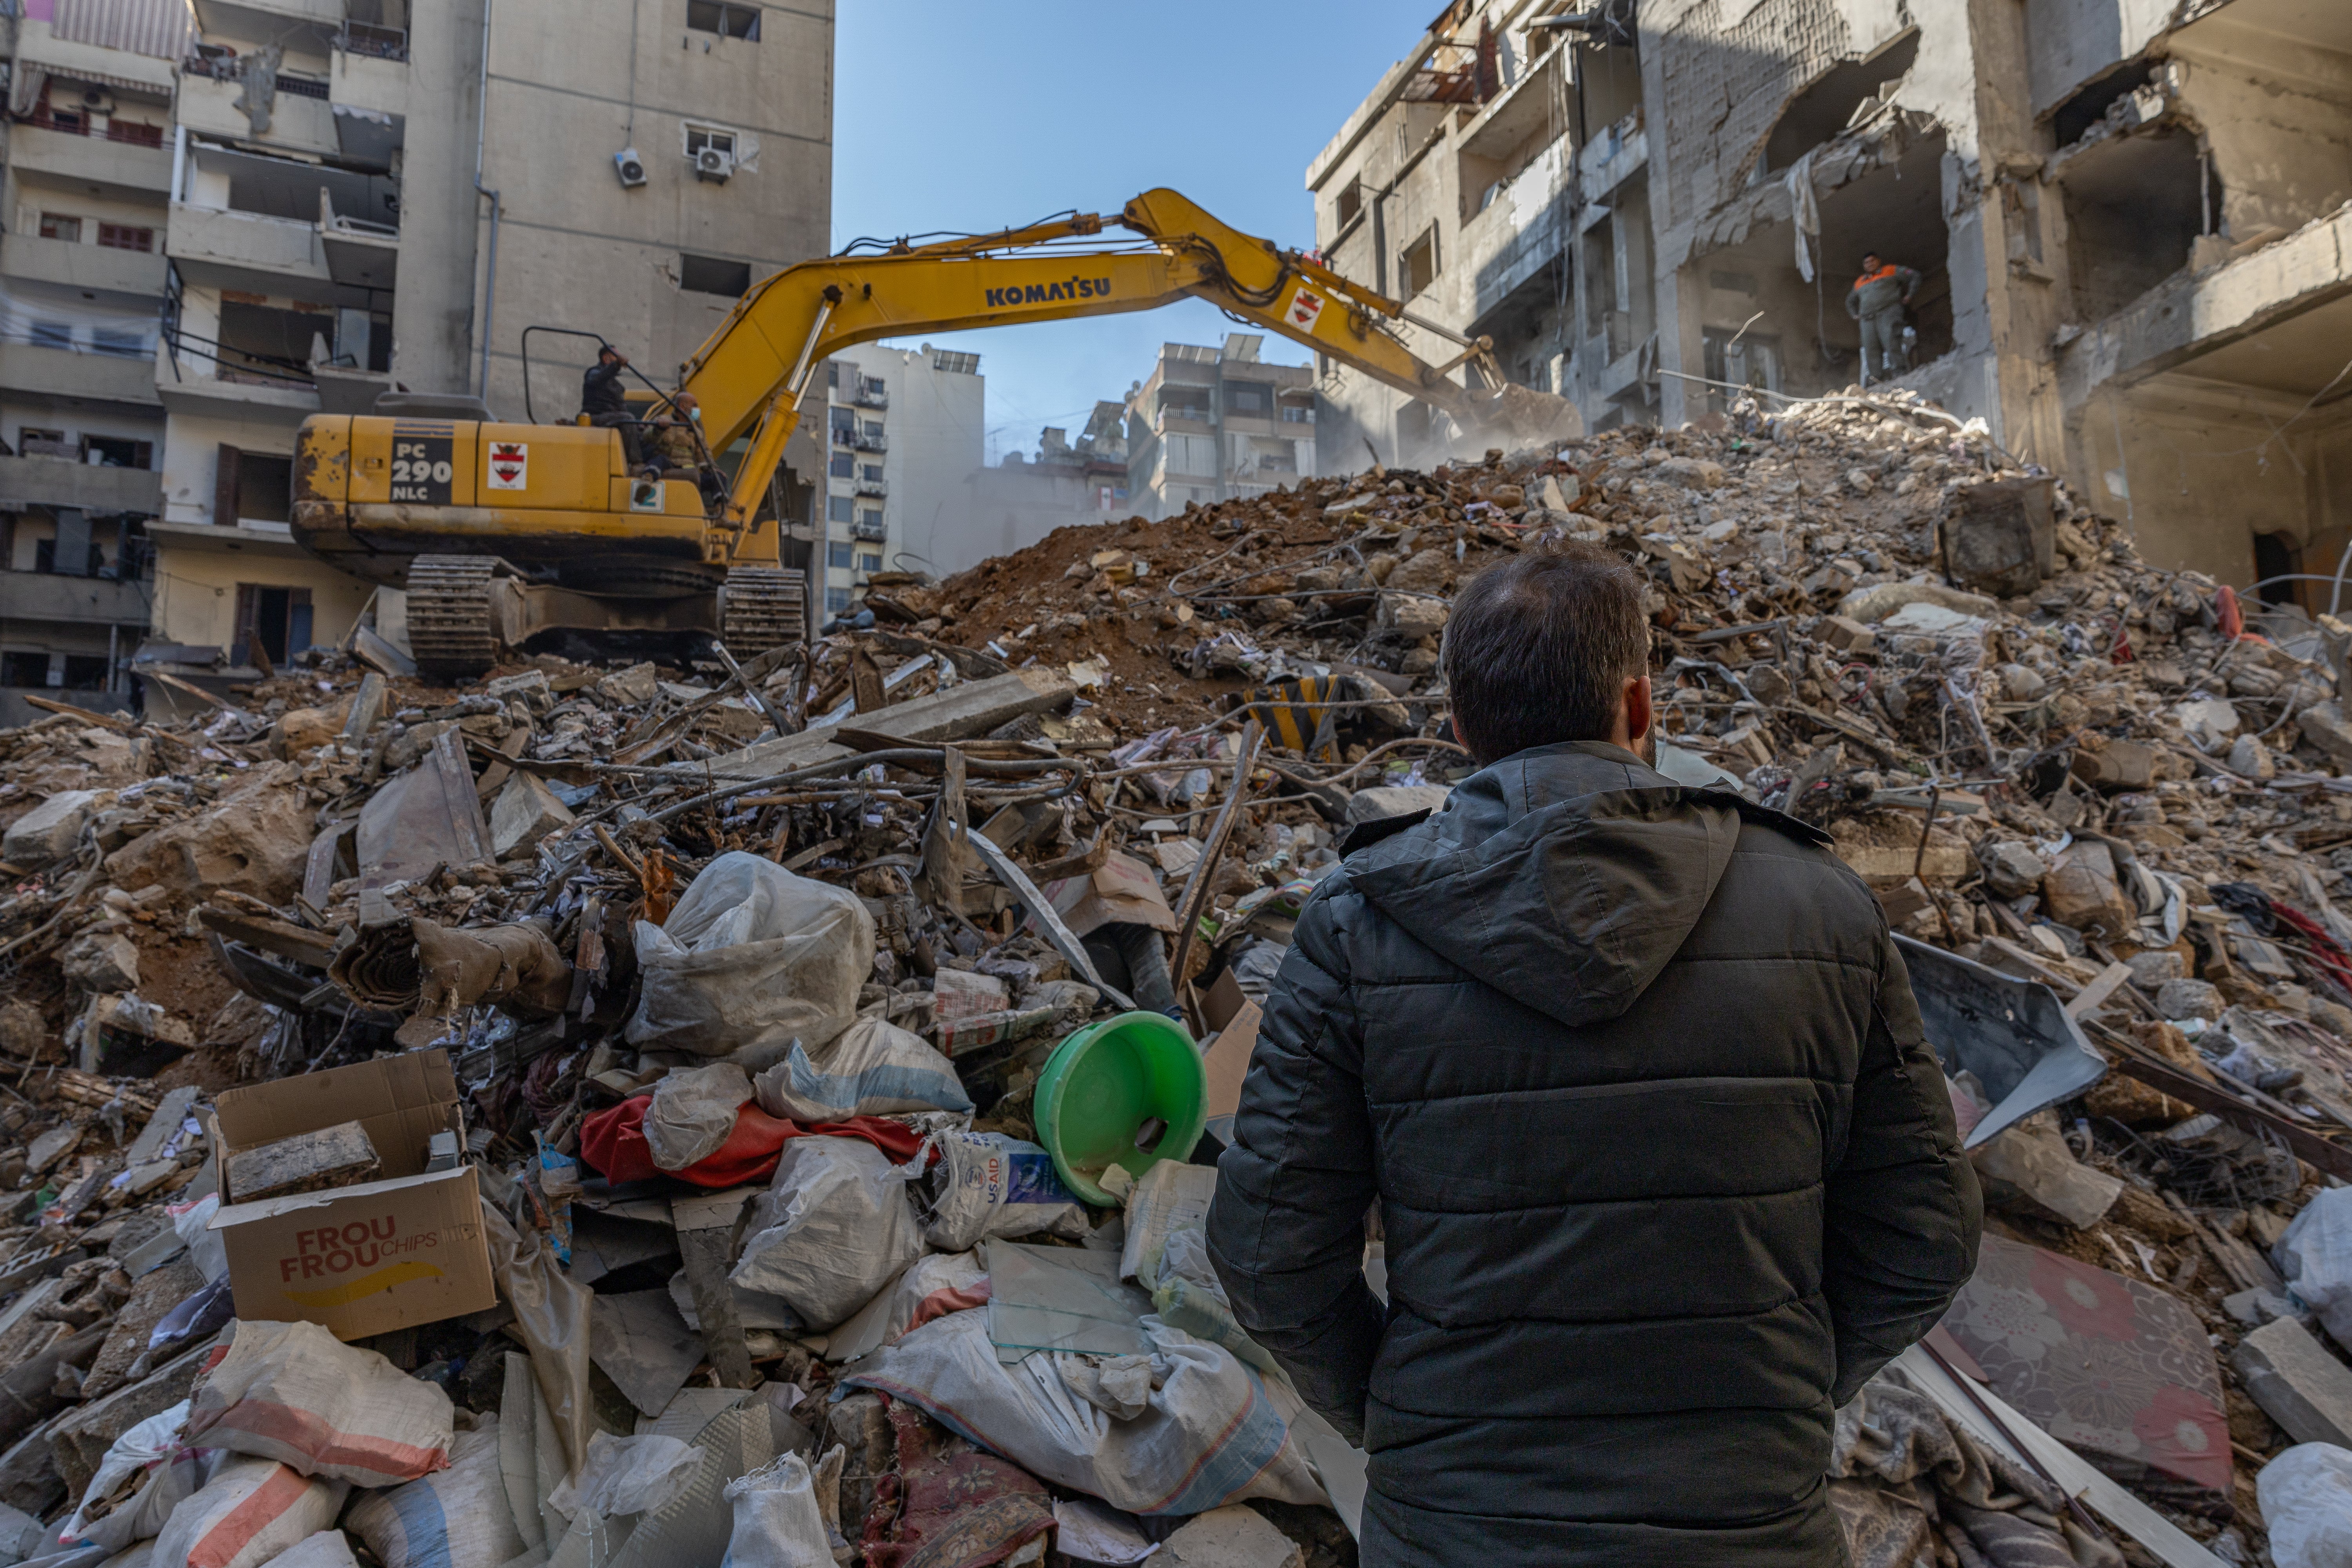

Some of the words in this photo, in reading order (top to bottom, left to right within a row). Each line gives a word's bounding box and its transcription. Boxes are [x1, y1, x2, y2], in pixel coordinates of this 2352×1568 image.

[985, 275, 1111, 307] KOMATSU
[396, 443, 426, 459] PC
[392, 459, 452, 484] 290
[392, 486, 428, 501] NLC
[639, 486, 656, 506] 2
[987, 1158, 1000, 1203] USAID
[296, 1215, 396, 1256] FROU
[279, 1244, 382, 1283] FROU
[381, 1232, 437, 1257] CHIPS
